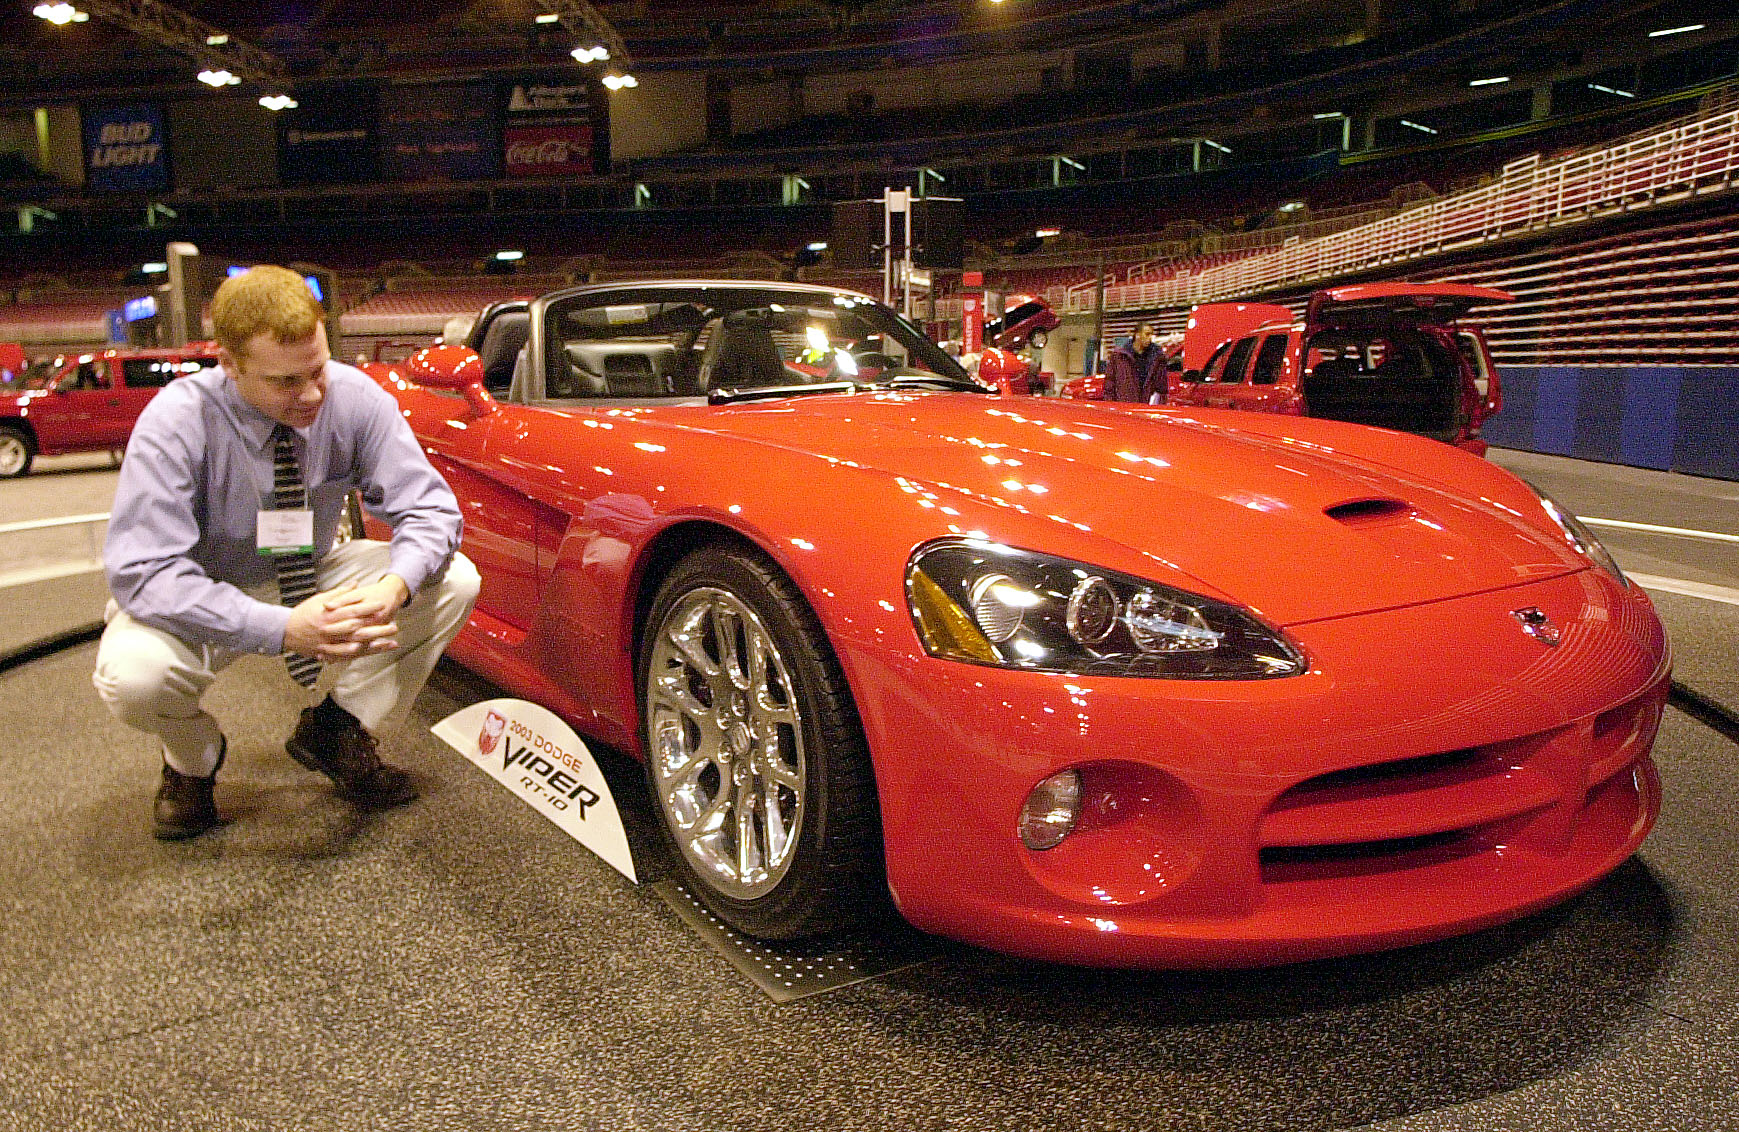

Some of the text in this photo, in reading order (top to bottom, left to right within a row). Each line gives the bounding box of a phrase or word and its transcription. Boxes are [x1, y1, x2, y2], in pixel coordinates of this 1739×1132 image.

[100, 122, 153, 144] BUD
[91, 144, 161, 167] LIGHT
[509, 720, 583, 774] 2003 DODGE
[503, 736, 600, 822] VIPER
